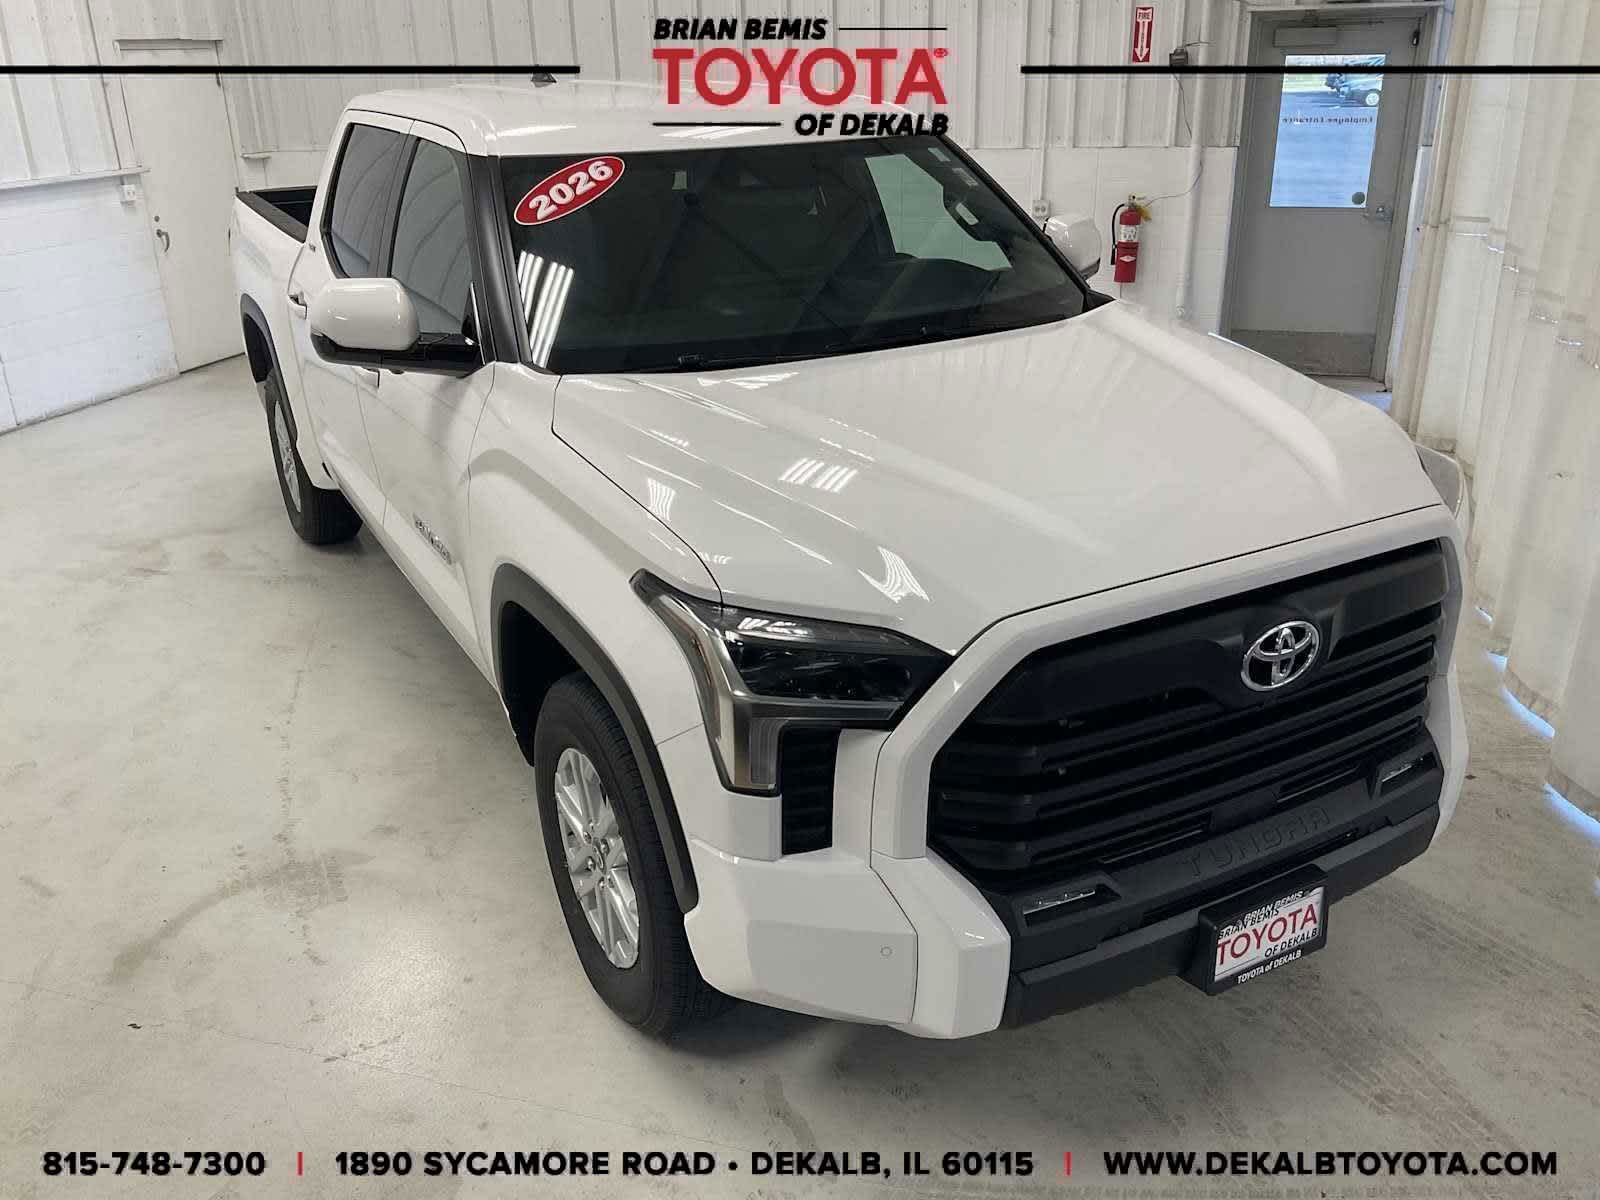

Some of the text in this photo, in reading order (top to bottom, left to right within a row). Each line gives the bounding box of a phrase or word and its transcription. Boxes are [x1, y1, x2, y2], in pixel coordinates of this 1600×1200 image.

[1138, 11, 1151, 20] FIRE
[528, 160, 614, 221] 2026
[1184, 807, 1331, 878] TUNDRA
[1217, 903, 1318, 965] TOYOTA
[1264, 927, 1318, 958] OF DEKALB
[1237, 966, 1265, 984] TOYOTA
[1273, 949, 1302, 968] DEKALB
